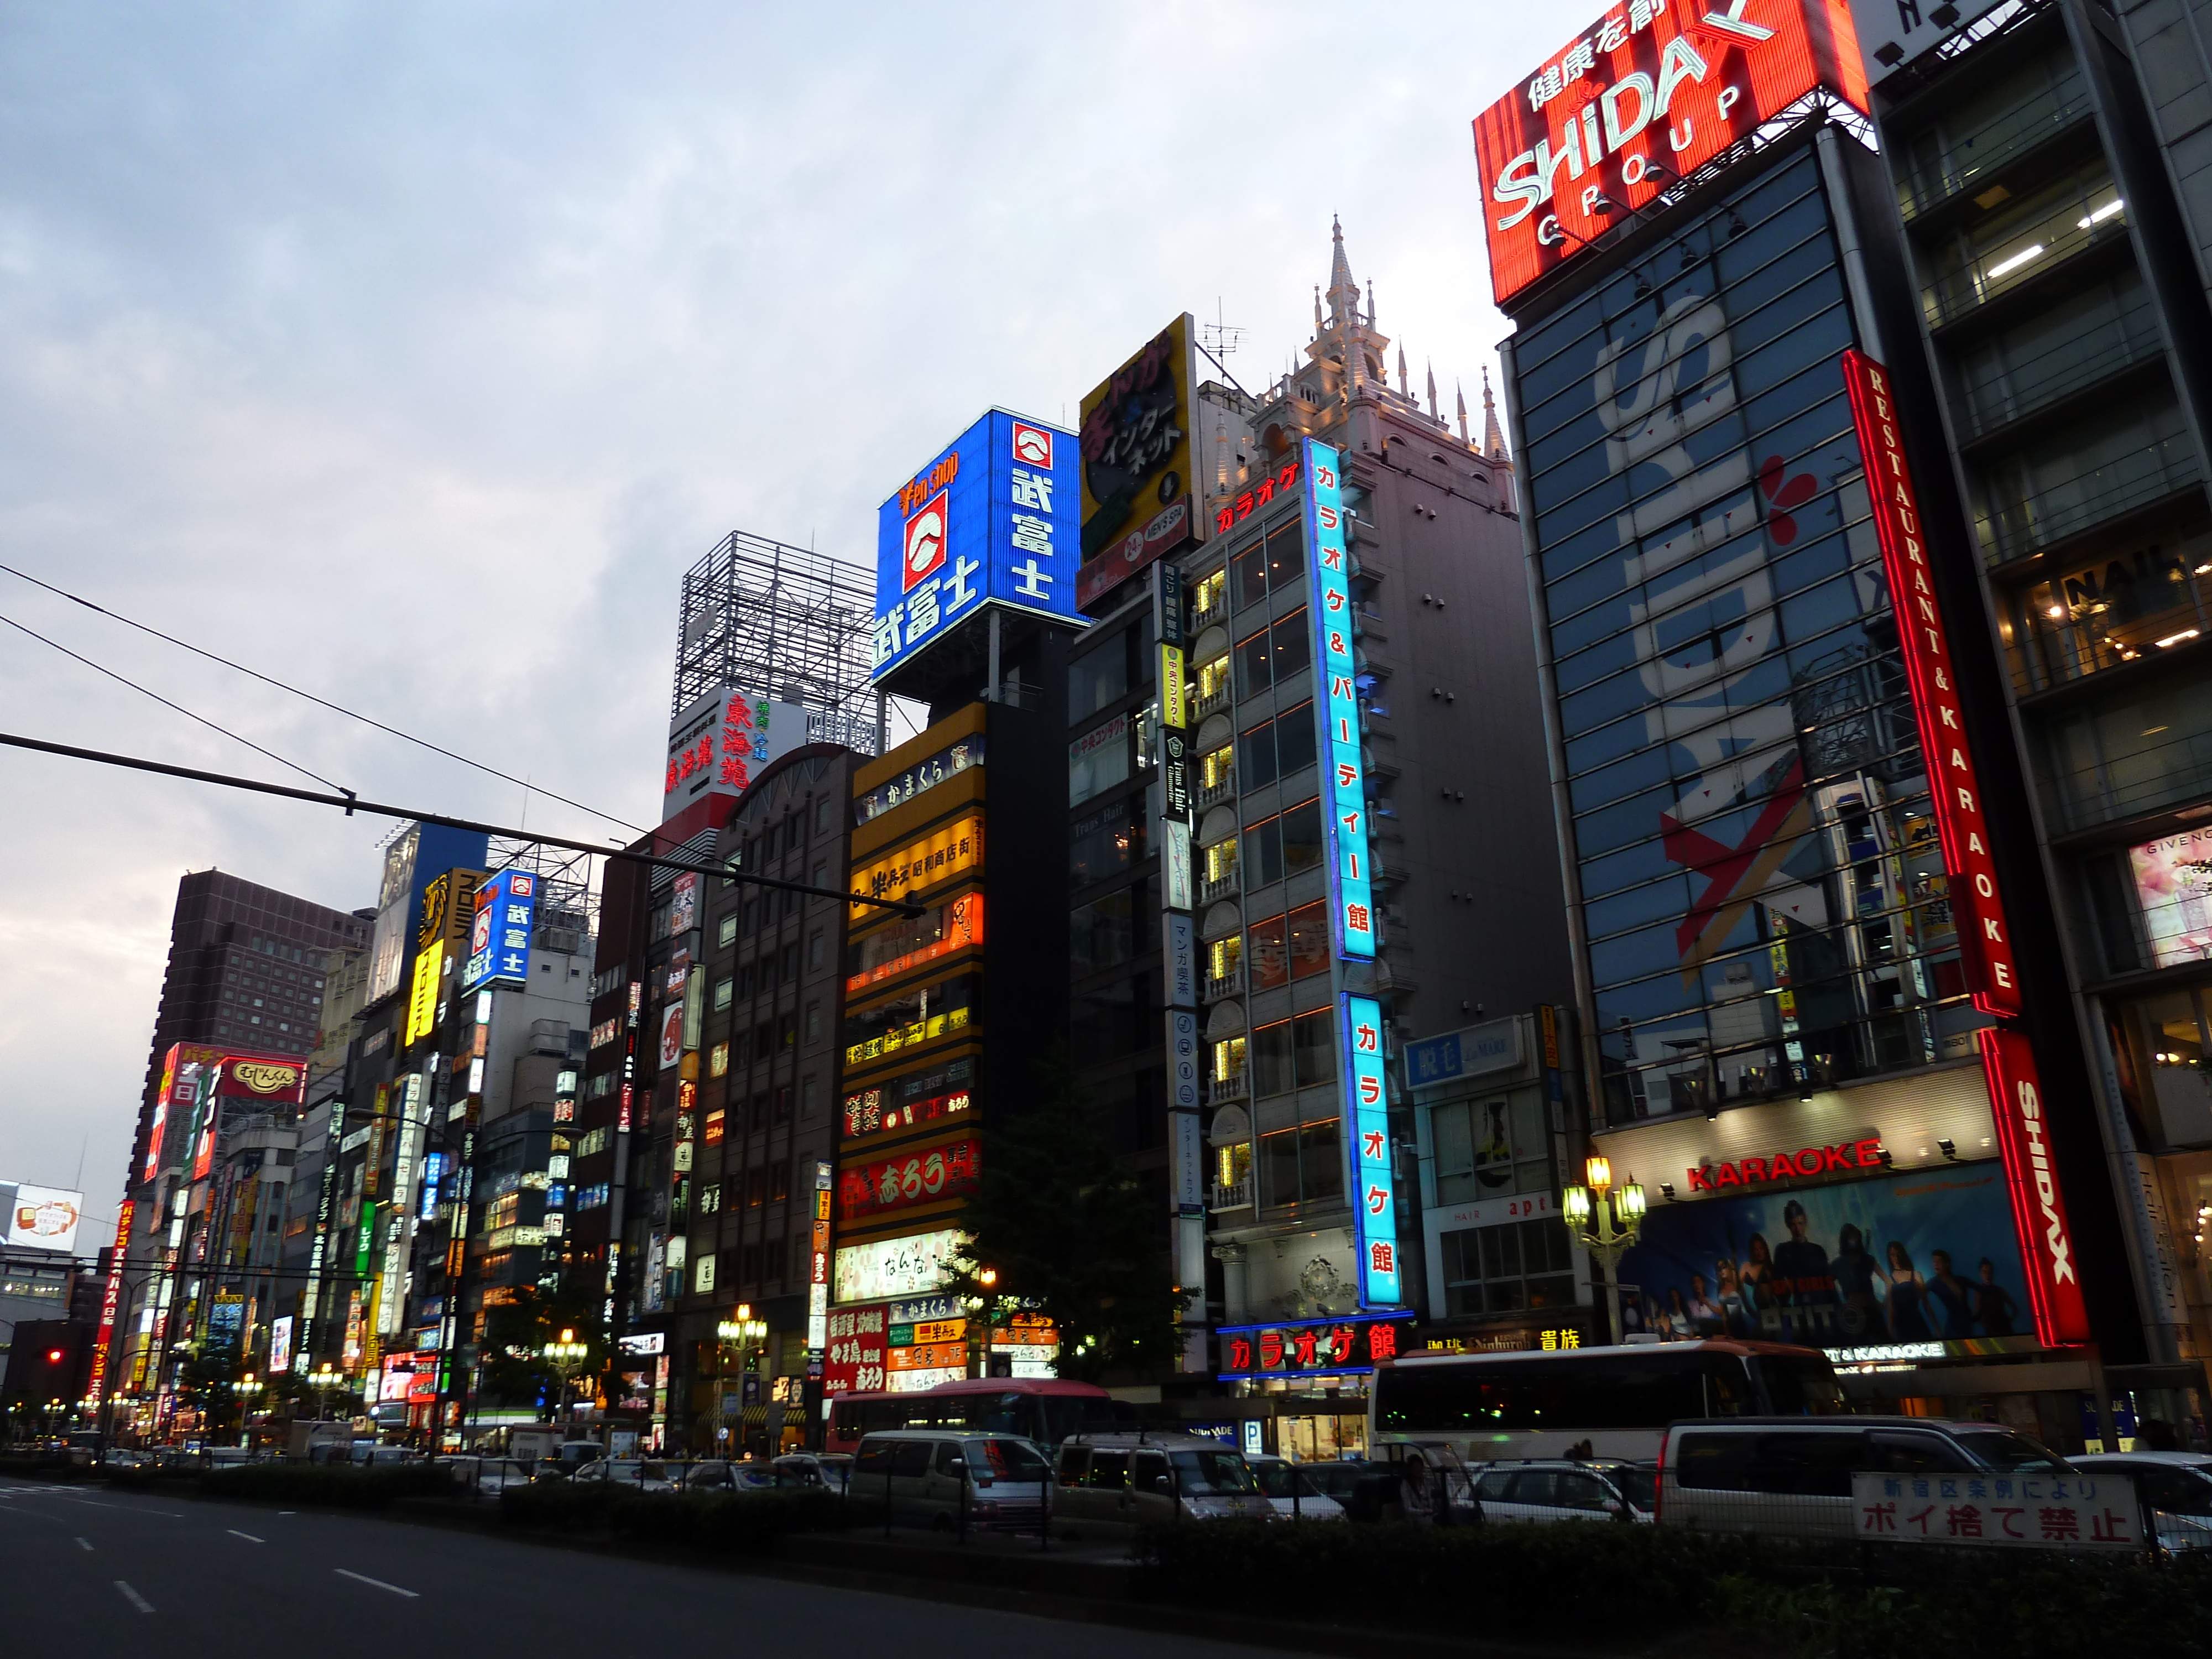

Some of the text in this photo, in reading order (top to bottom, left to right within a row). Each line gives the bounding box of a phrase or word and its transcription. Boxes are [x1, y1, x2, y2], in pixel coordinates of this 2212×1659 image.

[930, 451, 959, 494] shop
[1217, 463, 1299, 534] カラオケ
[1011, 468, 1053, 601] 武富士
[871, 555, 979, 671] 武富士
[1168, 660, 1180, 726] 中央コンタクト
[1867, 366, 2013, 989] RESTAURANT & KARAOKE
[717, 693, 754, 790] 東海苑
[1080, 716, 1126, 756] 中央コンタクト
[886, 760, 943, 805] かまくら
[1174, 760, 1186, 813] Trans Hair
[1103, 802, 1125, 825] Hair
[912, 836, 970, 877] 昭和商店街
[503, 904, 530, 973] 武富士
[1176, 925, 1190, 995] マンガ喫茶
[1357, 1022, 1395, 1274] カラオケ館
[1687, 1136, 1884, 1192] KARAOKE
[2017, 1080, 2075, 1286] SHIDAX
[359, 1227, 372, 1252] レイク
[908, 1298, 947, 1319] かまくら
[950, 1347, 961, 1362] 7F
[1230, 1323, 1396, 1369] カラオケ館
[1540, 1328, 1580, 1351] 貴族
[1854, 1343, 1943, 1361] KARAOKE
[1248, 1425, 1257, 1444] P
[1884, 1478, 2098, 1500] 新宿区条例により
[1863, 1502, 2131, 1543] ポイ捨て禁止
